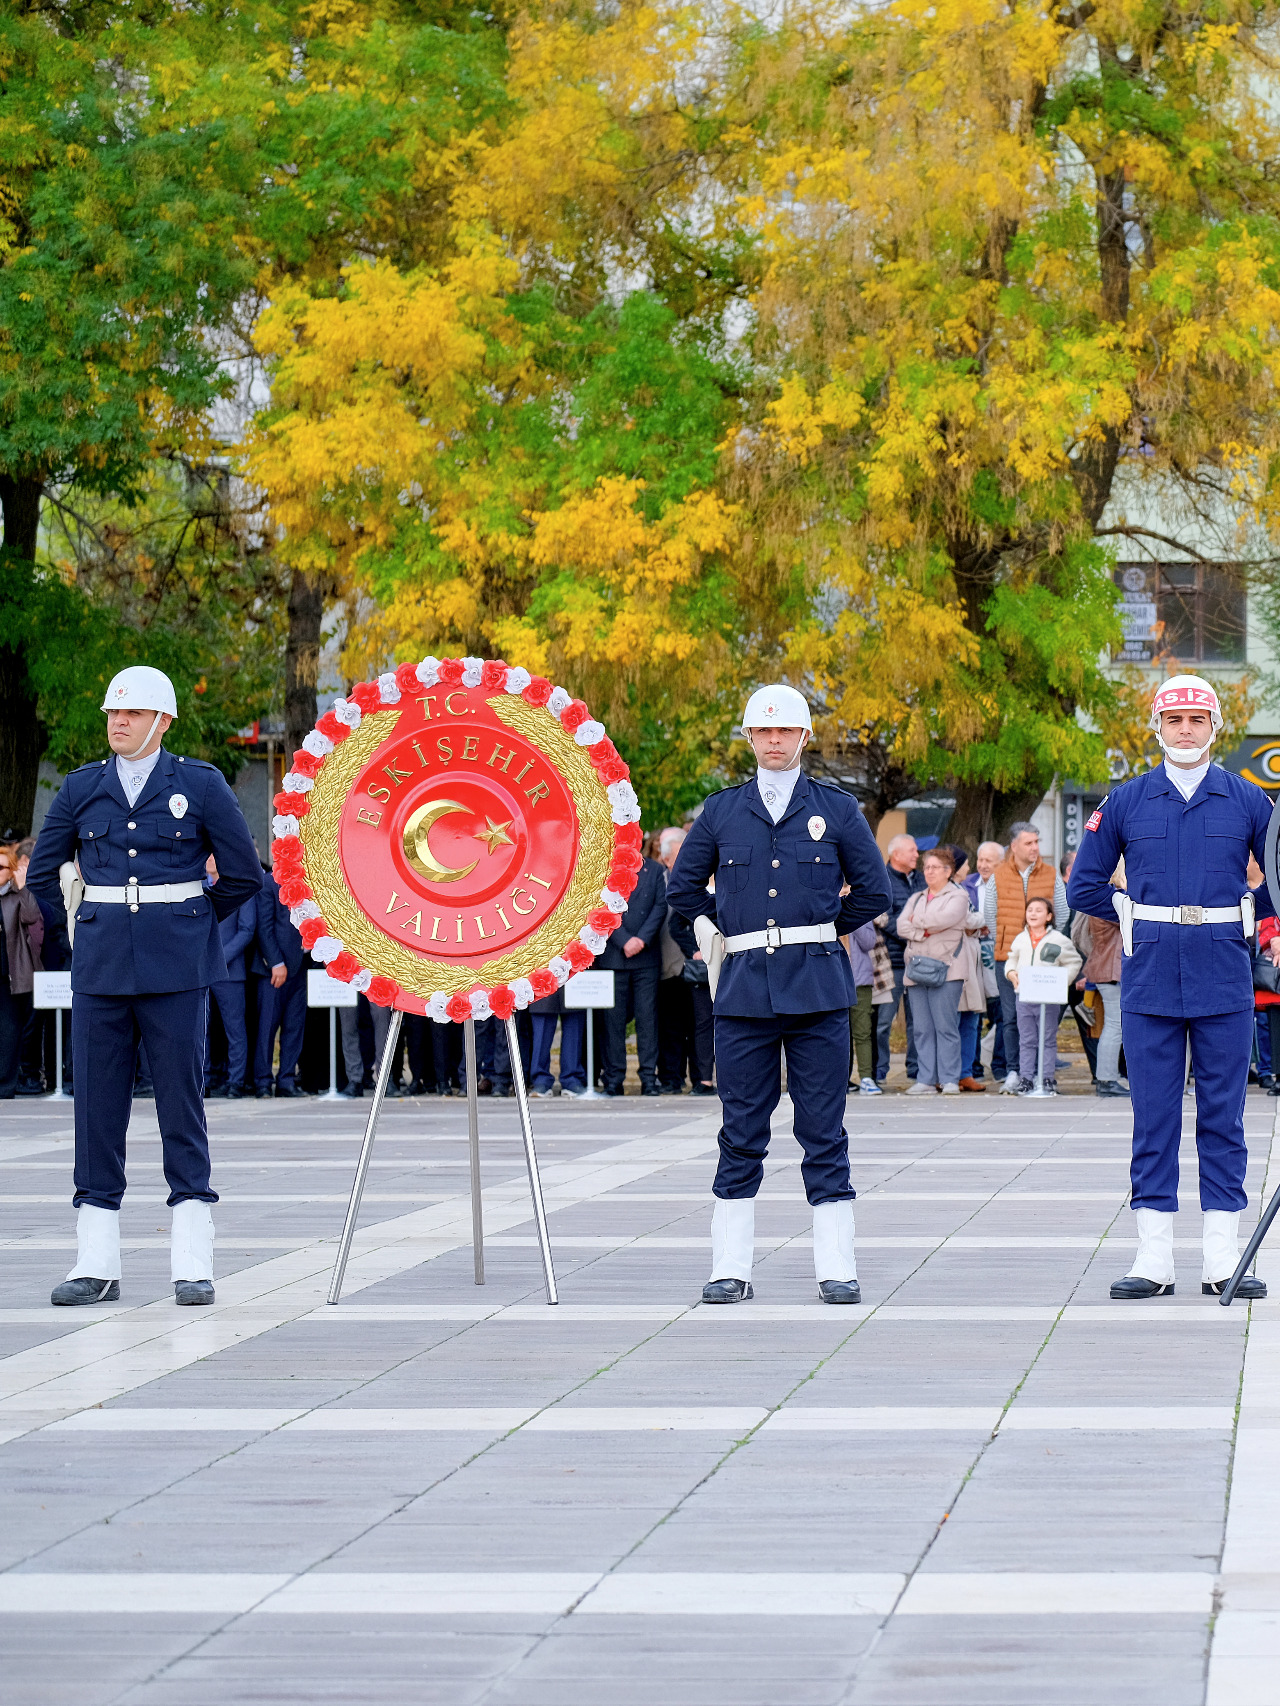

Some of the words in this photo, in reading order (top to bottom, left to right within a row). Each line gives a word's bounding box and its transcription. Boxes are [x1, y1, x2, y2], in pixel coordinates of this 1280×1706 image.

[415, 691, 477, 721] T.C.
[357, 735, 551, 830] ESKİŞEHİR
[385, 872, 553, 944] VALİLİĞİ
